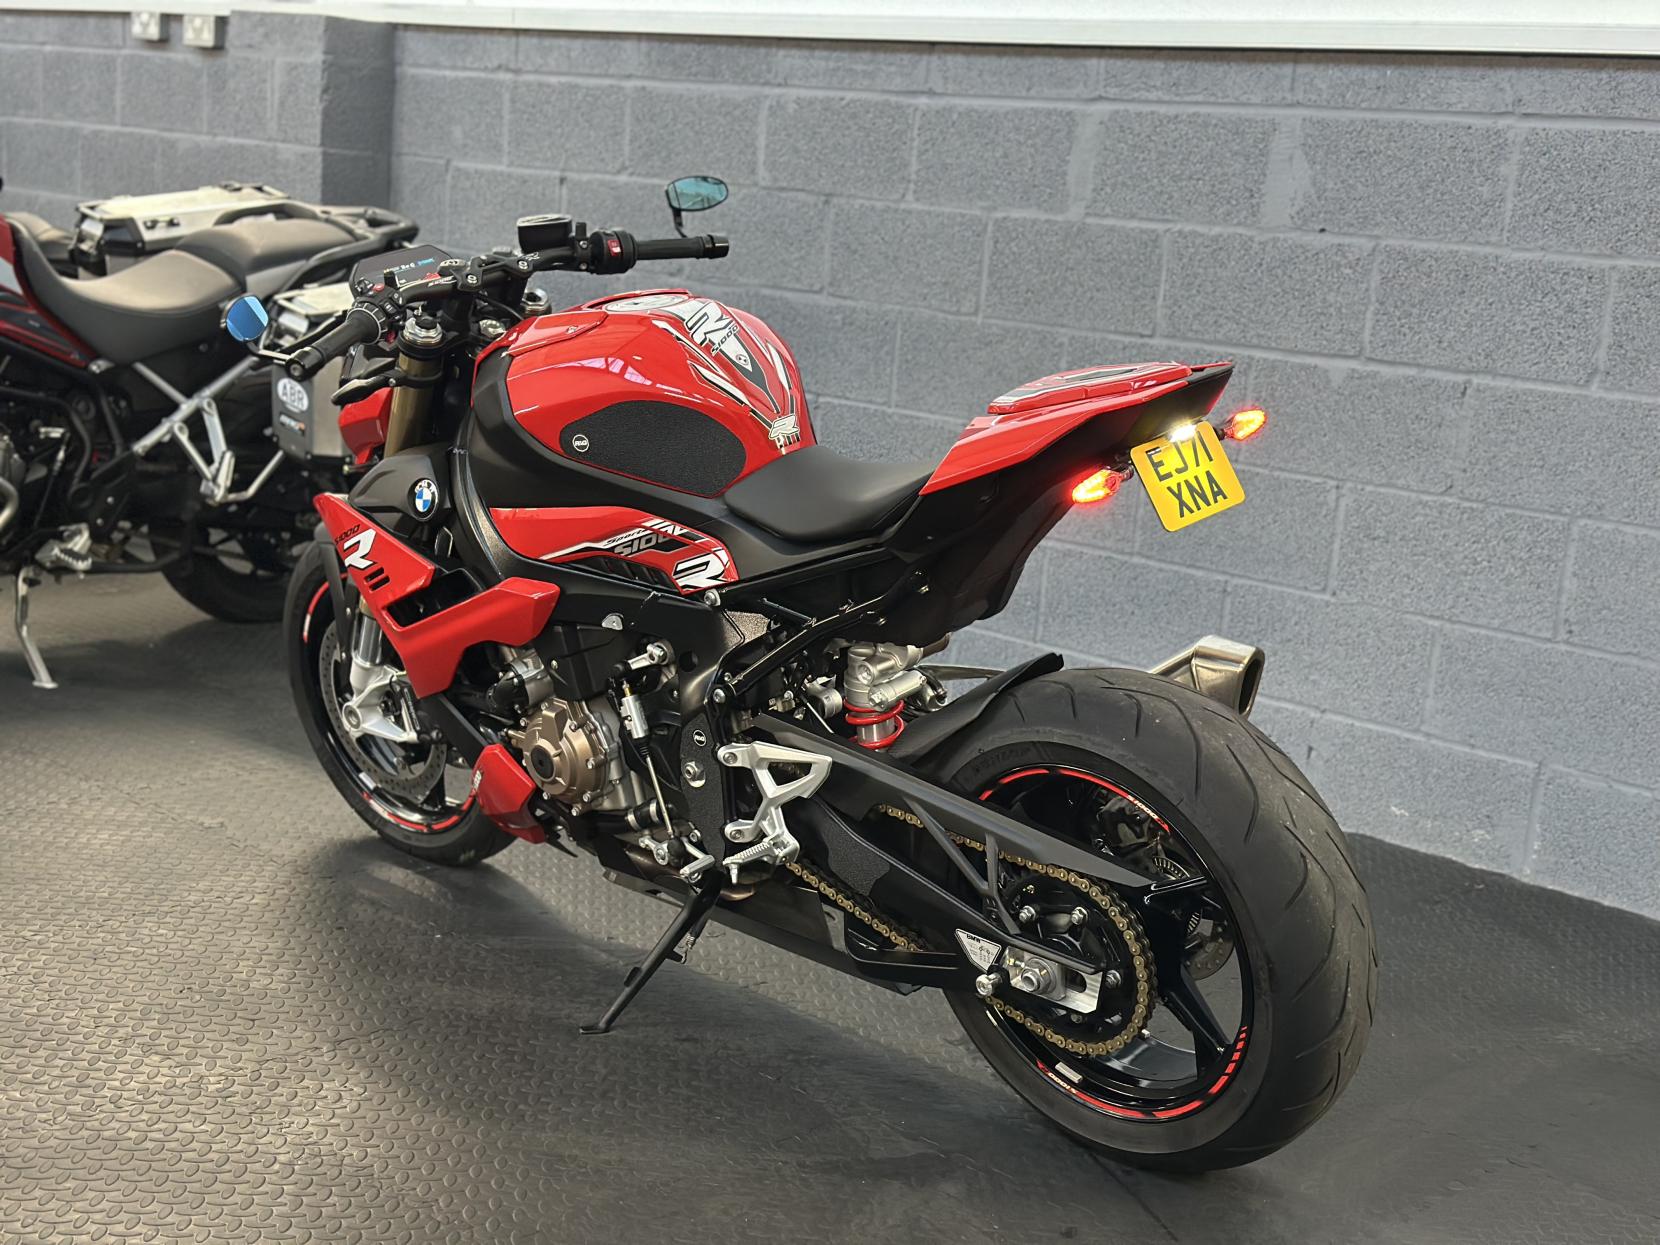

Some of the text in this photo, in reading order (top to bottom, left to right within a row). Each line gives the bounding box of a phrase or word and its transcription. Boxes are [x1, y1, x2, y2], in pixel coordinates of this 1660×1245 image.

[711, 323, 738, 353] S1000
[281, 382, 305, 409] ABR
[1145, 430, 1213, 482] EJ71
[1166, 469, 1228, 518] XNA
